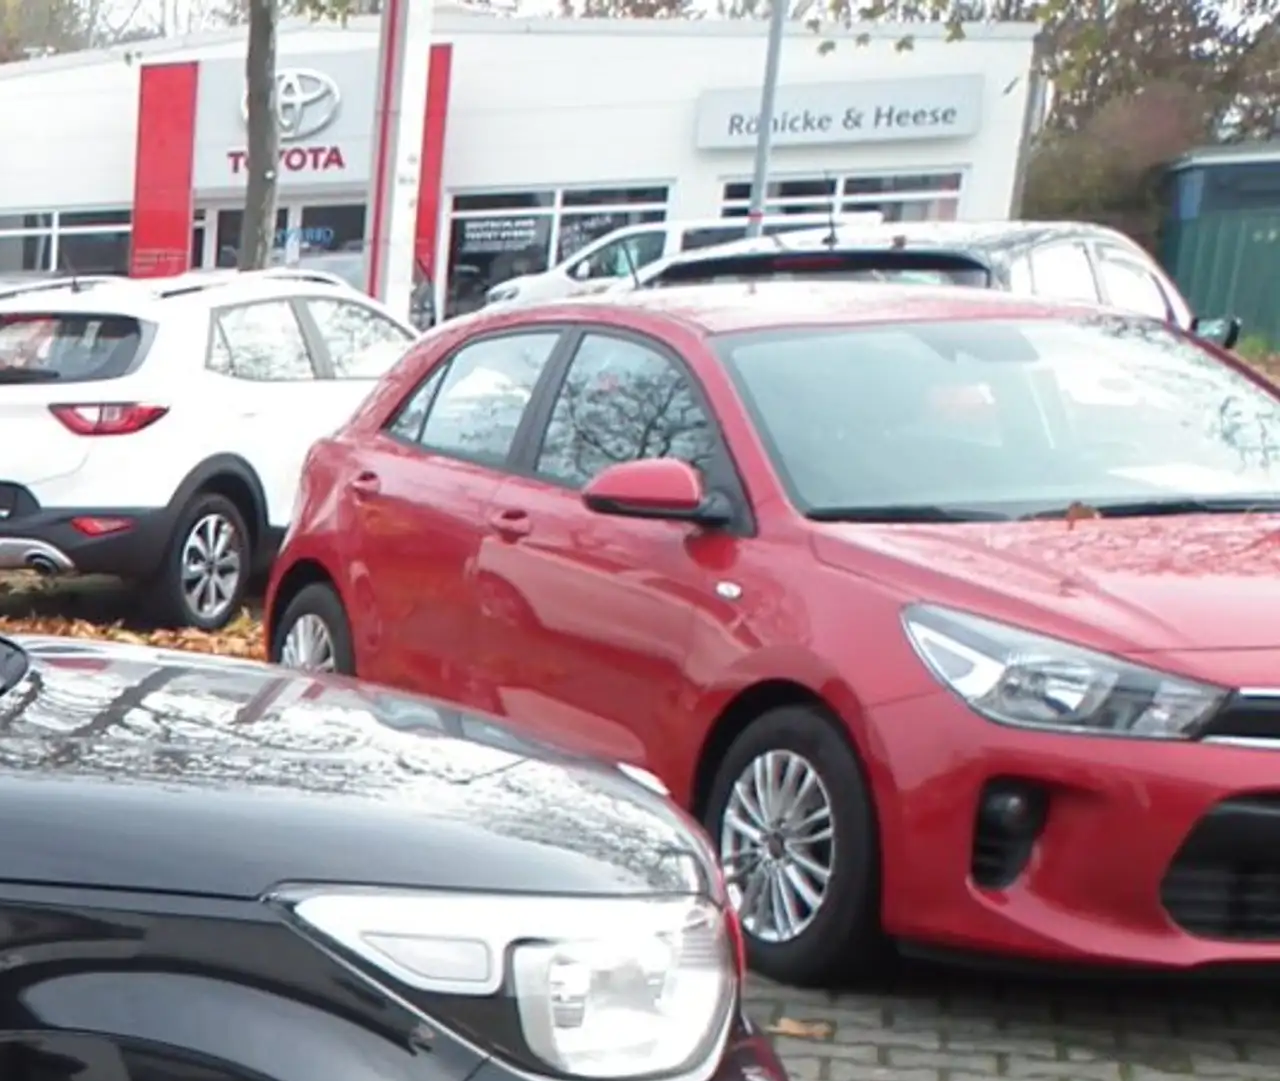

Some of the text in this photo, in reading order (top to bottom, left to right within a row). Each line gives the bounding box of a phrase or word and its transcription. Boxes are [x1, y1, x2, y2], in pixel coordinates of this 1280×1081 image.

[842, 107, 865, 131] &
[874, 104, 958, 128] Heese
[227, 146, 345, 173] TOTA
